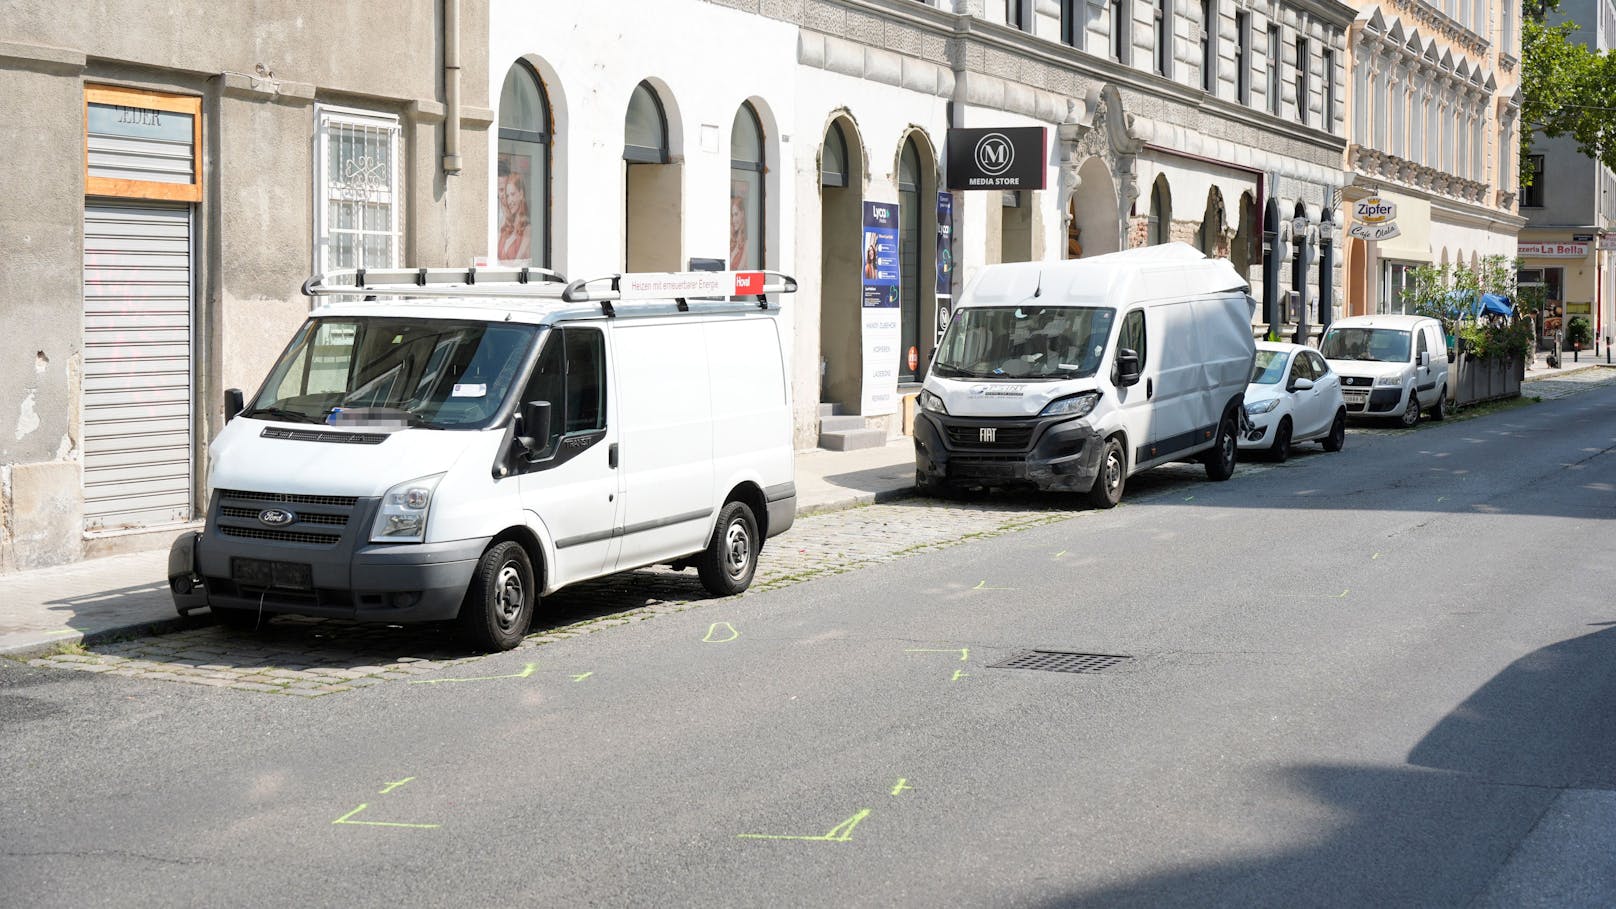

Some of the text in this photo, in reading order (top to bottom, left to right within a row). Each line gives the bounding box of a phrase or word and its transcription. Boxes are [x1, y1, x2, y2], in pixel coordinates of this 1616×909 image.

[984, 144, 1005, 163] M
[995, 177, 1020, 185] STORE
[1358, 204, 1392, 216] Zipfer
[1541, 245, 1554, 254] La
[1557, 245, 1584, 254] Bella
[631, 281, 651, 291] Heizen
[653, 281, 662, 290] mit
[699, 279, 719, 291] Energie
[980, 427, 997, 442] FIAT
[264, 511, 284, 522] Ford
